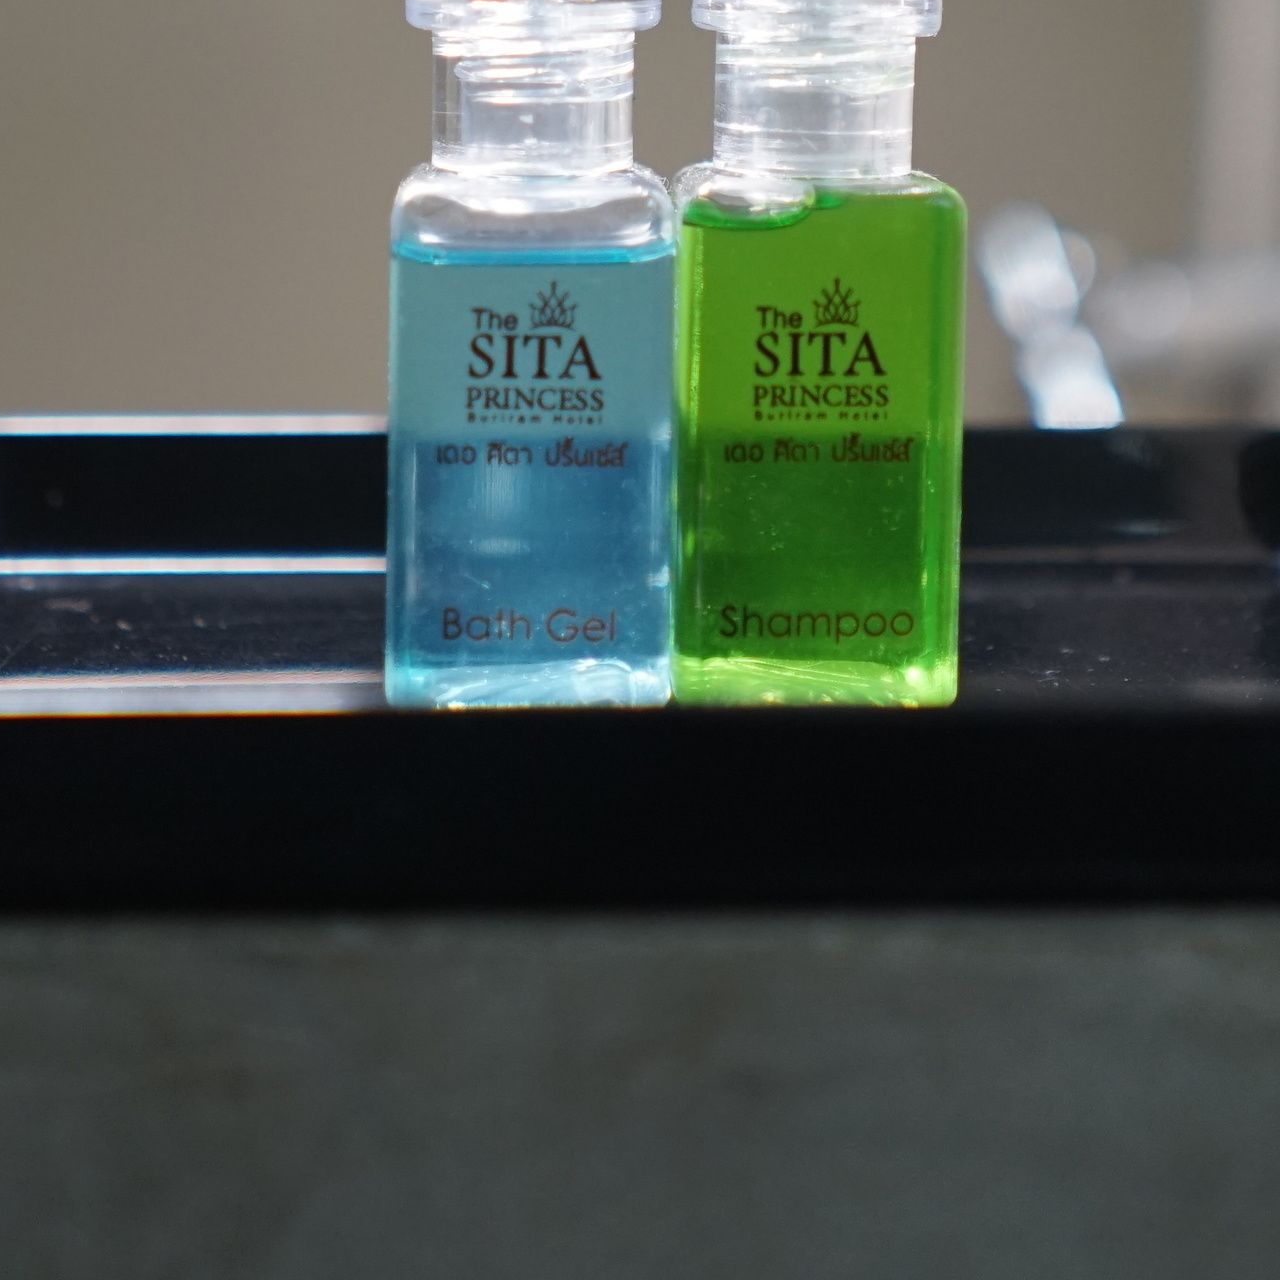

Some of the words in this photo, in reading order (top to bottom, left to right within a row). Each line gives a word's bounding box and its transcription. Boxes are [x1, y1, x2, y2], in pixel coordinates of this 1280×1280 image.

[472, 307, 519, 330] The
[756, 305, 803, 329] The
[468, 333, 602, 380] SITA
[754, 331, 888, 377] SITA
[465, 387, 605, 412] PRINCESS
[753, 384, 890, 408] PRINCESS
[442, 606, 531, 641] Bath
[546, 607, 616, 642] Gel
[719, 604, 915, 645] Shampoo
